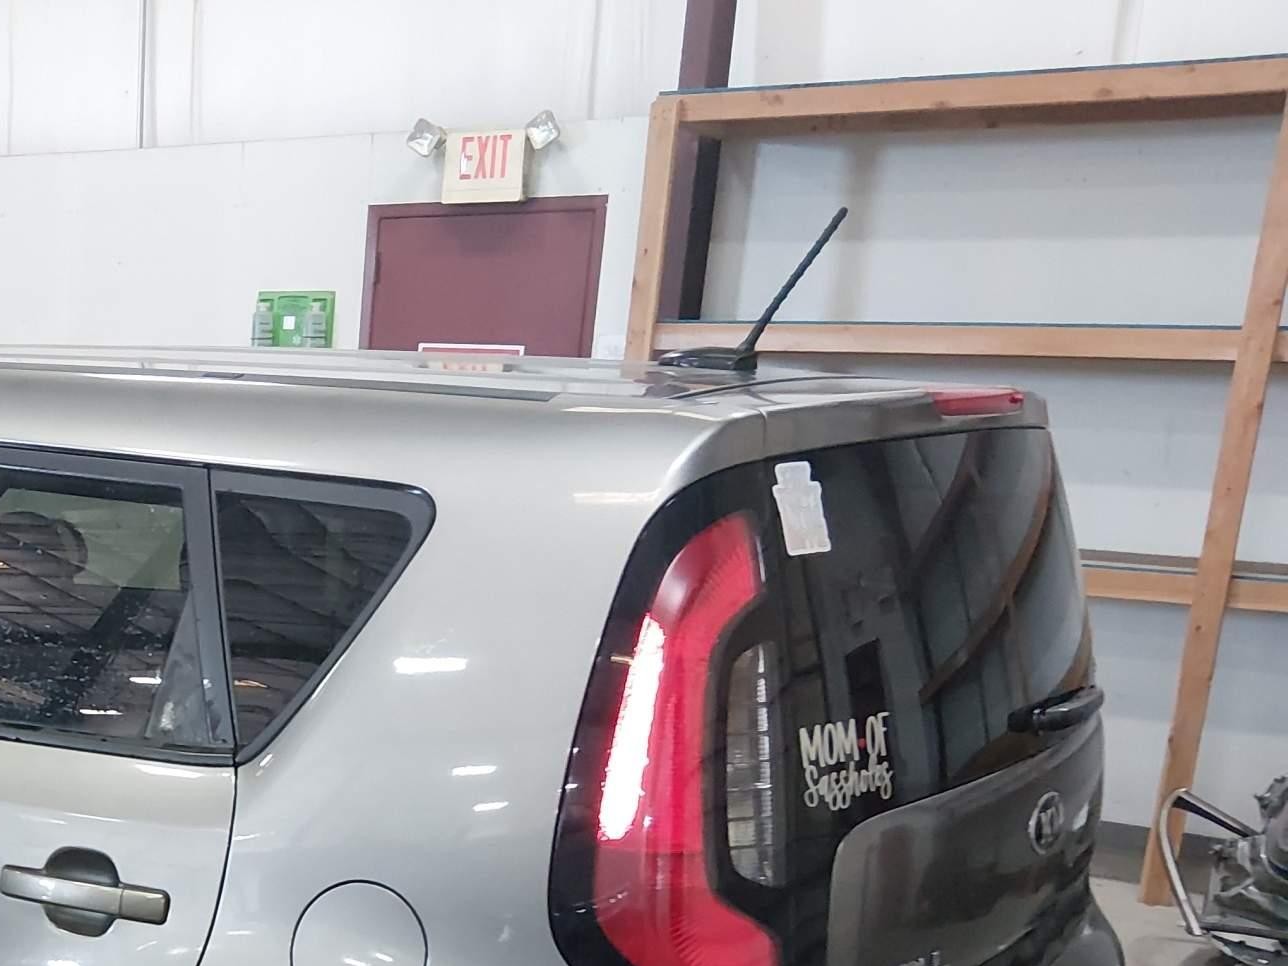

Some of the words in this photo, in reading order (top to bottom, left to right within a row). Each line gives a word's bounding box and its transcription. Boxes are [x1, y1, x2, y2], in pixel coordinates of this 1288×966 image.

[459, 134, 513, 179] EXIT
[799, 718, 860, 768] MOM
[865, 711, 890, 756] OF
